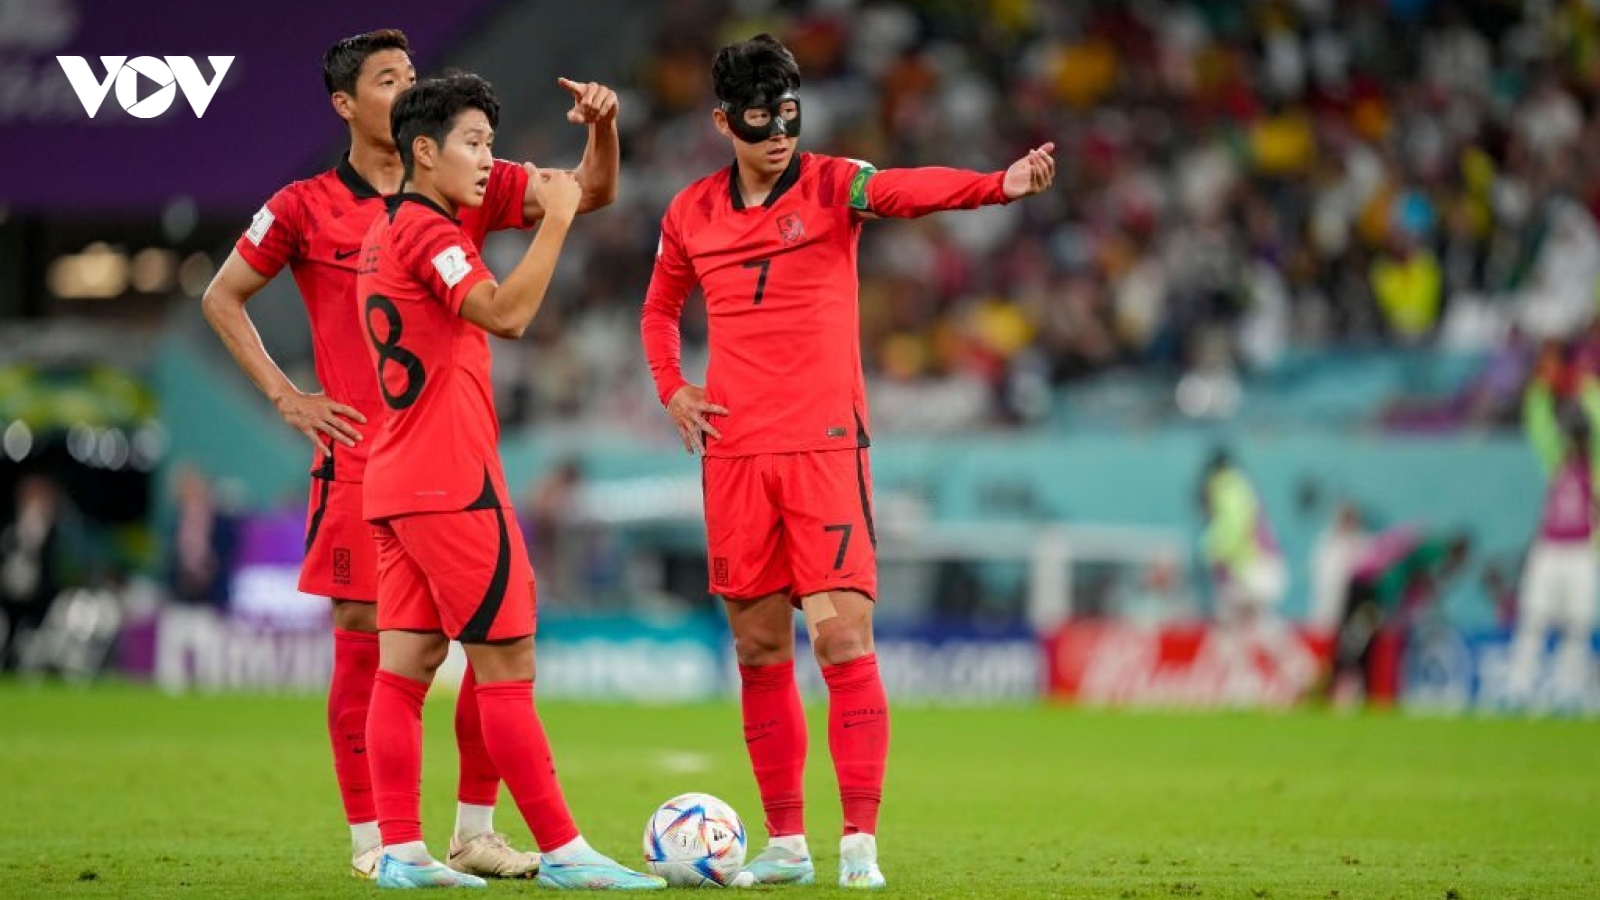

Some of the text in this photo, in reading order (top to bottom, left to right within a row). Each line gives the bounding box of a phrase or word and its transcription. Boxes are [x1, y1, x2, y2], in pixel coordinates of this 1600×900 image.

[742, 259, 771, 305] 7
[365, 293, 426, 411] 8
[824, 523, 853, 571] 7
